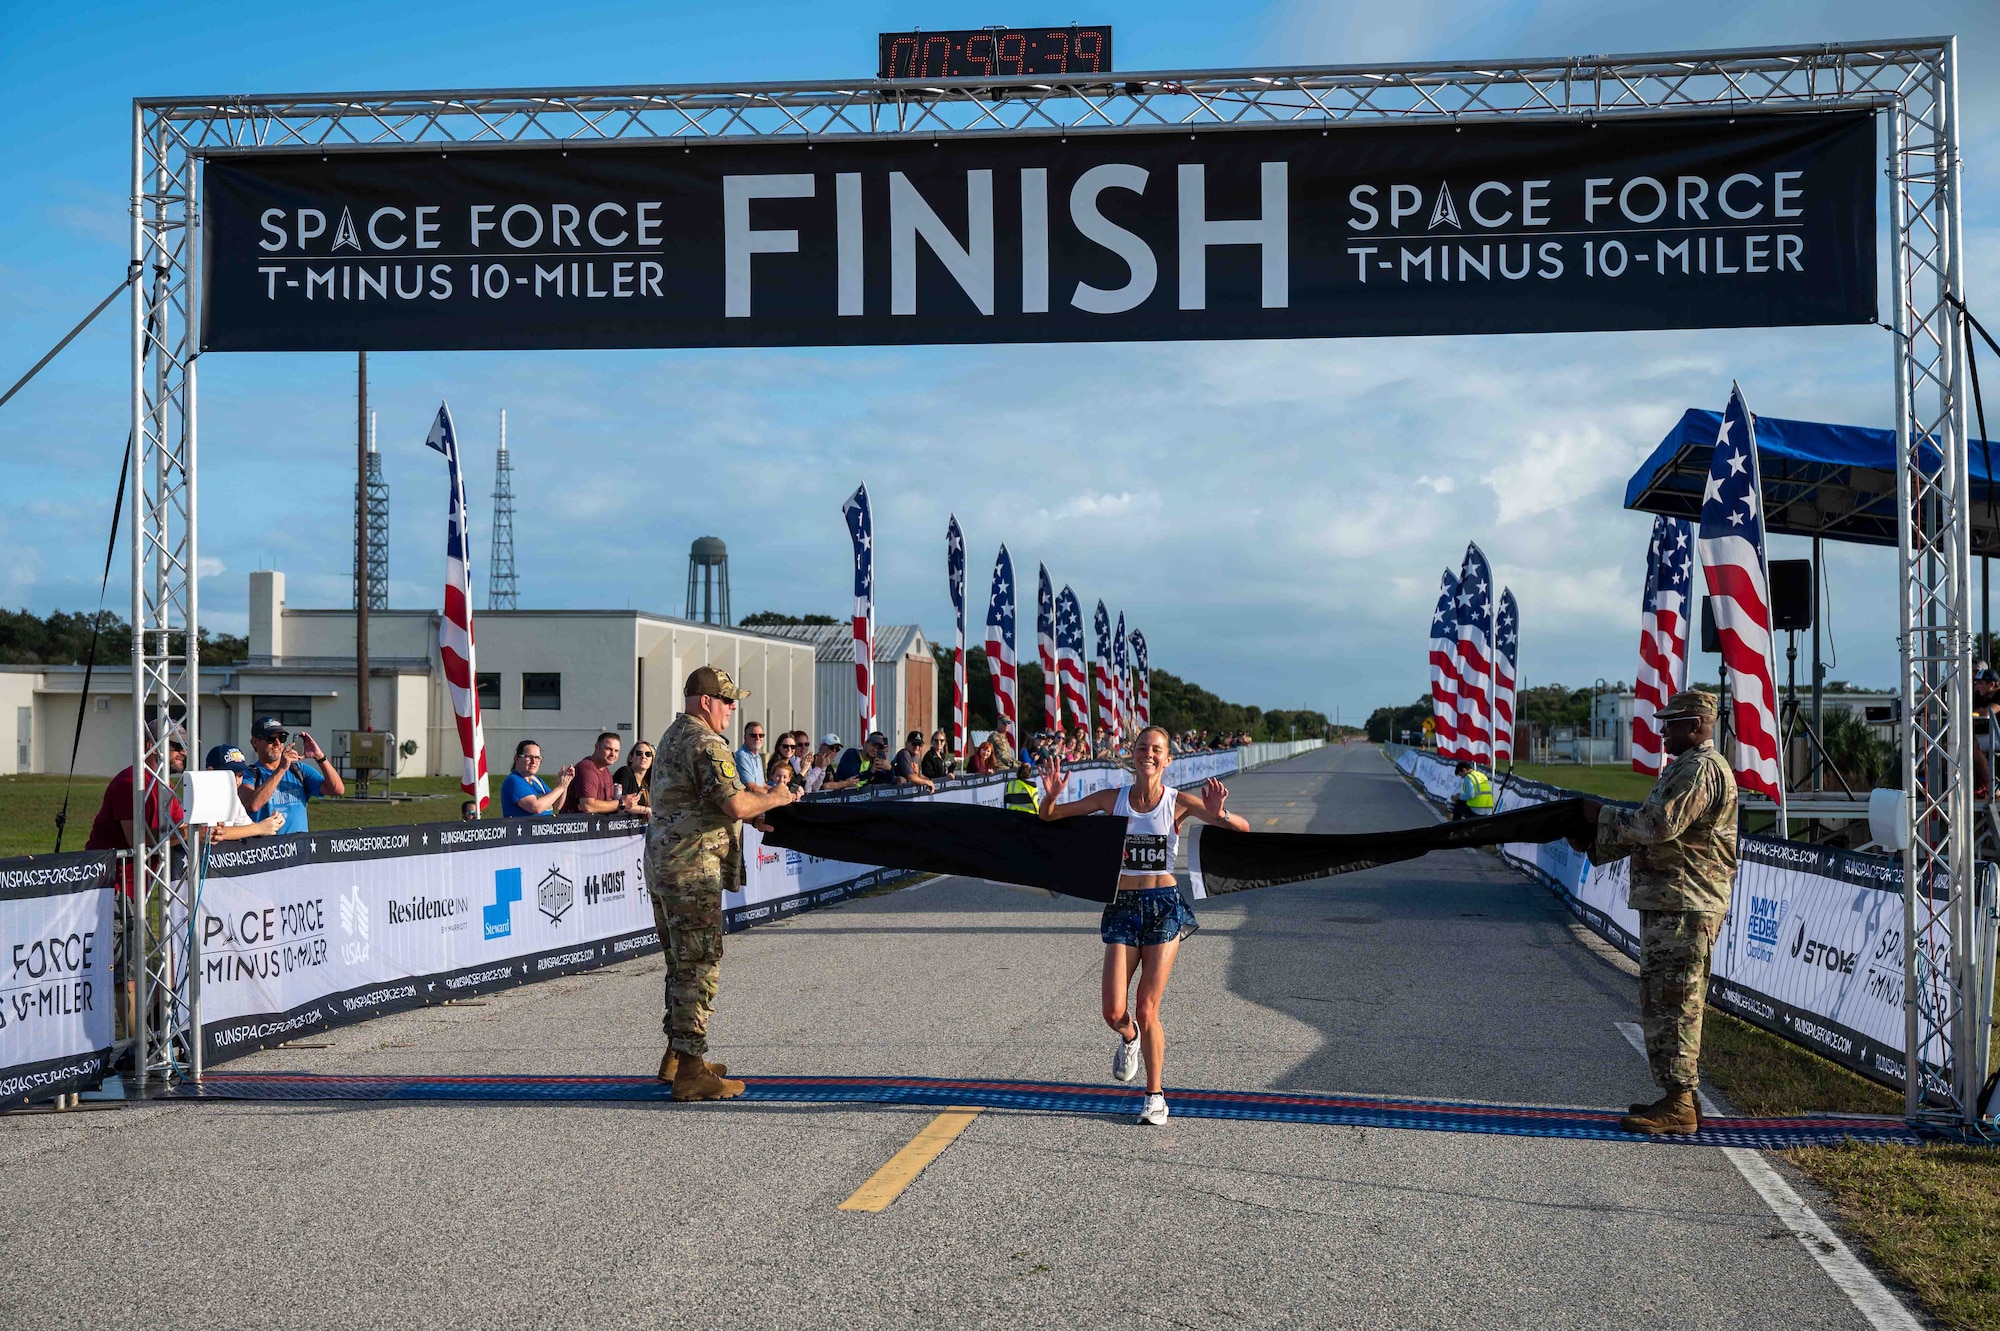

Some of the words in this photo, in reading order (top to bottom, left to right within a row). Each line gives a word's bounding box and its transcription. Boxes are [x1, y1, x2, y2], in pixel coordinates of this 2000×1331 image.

[1347, 180, 1551, 231] SPACE
[1585, 171, 1804, 223] FORCE
[259, 205, 441, 252] SPACE
[470, 201, 664, 248] FORCE
[723, 162, 1289, 318] FINISH
[1347, 241, 1565, 284] T-MINUS
[1583, 234, 1804, 278] 10-MILER
[259, 263, 453, 300] T-MINUS
[470, 261, 664, 298] 10-MILER
[440, 826, 507, 845] RUNSPACEFORCE.COM
[532, 821, 589, 837] RUNSPACEFORCE.COM
[208, 842, 298, 869] RUNSPACEFORCE.COM
[331, 834, 410, 853] RUNSPACEFORCE.COM
[1130, 848, 1166, 862] 1164
[601, 870, 626, 895] HOIST
[388, 895, 454, 925] Residence
[1751, 895, 1779, 919] NAVY
[204, 909, 275, 947] PACE
[281, 899, 324, 937] FORCE
[485, 918, 510, 937] Steward
[13, 932, 95, 981] FORCE
[200, 950, 280, 985] -MINUS
[341, 942, 370, 966] USAA
[538, 949, 595, 971] RUNSPACEFORCE.COM
